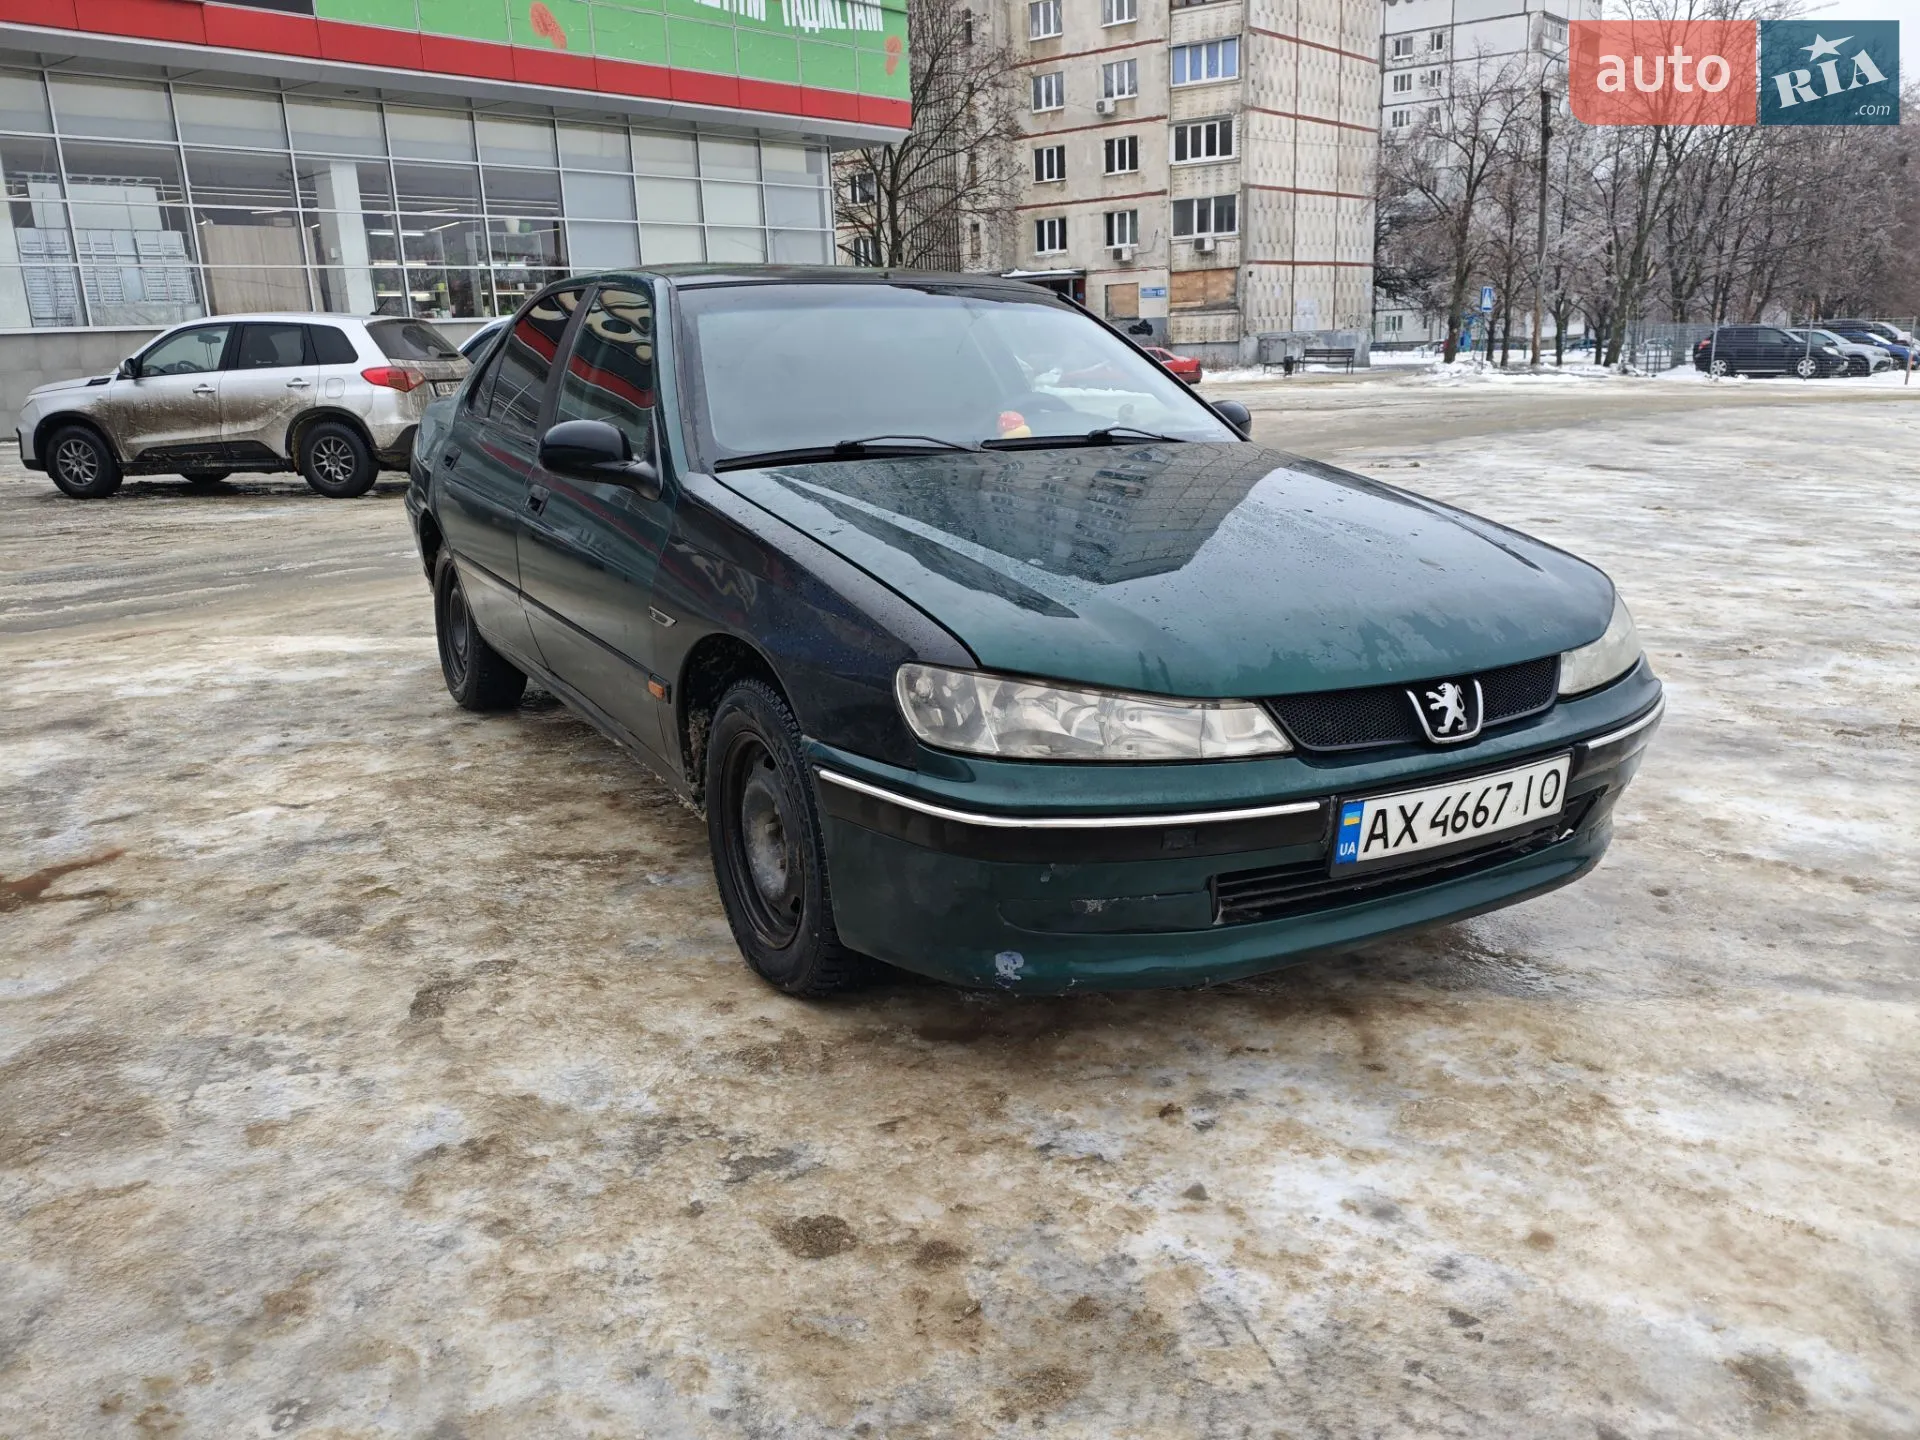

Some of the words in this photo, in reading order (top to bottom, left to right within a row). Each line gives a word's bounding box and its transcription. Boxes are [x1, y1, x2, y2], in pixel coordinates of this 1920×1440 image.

[1363, 801, 1424, 853] AX
[1429, 781, 1514, 837] 4667
[1339, 841, 1357, 857] UA
